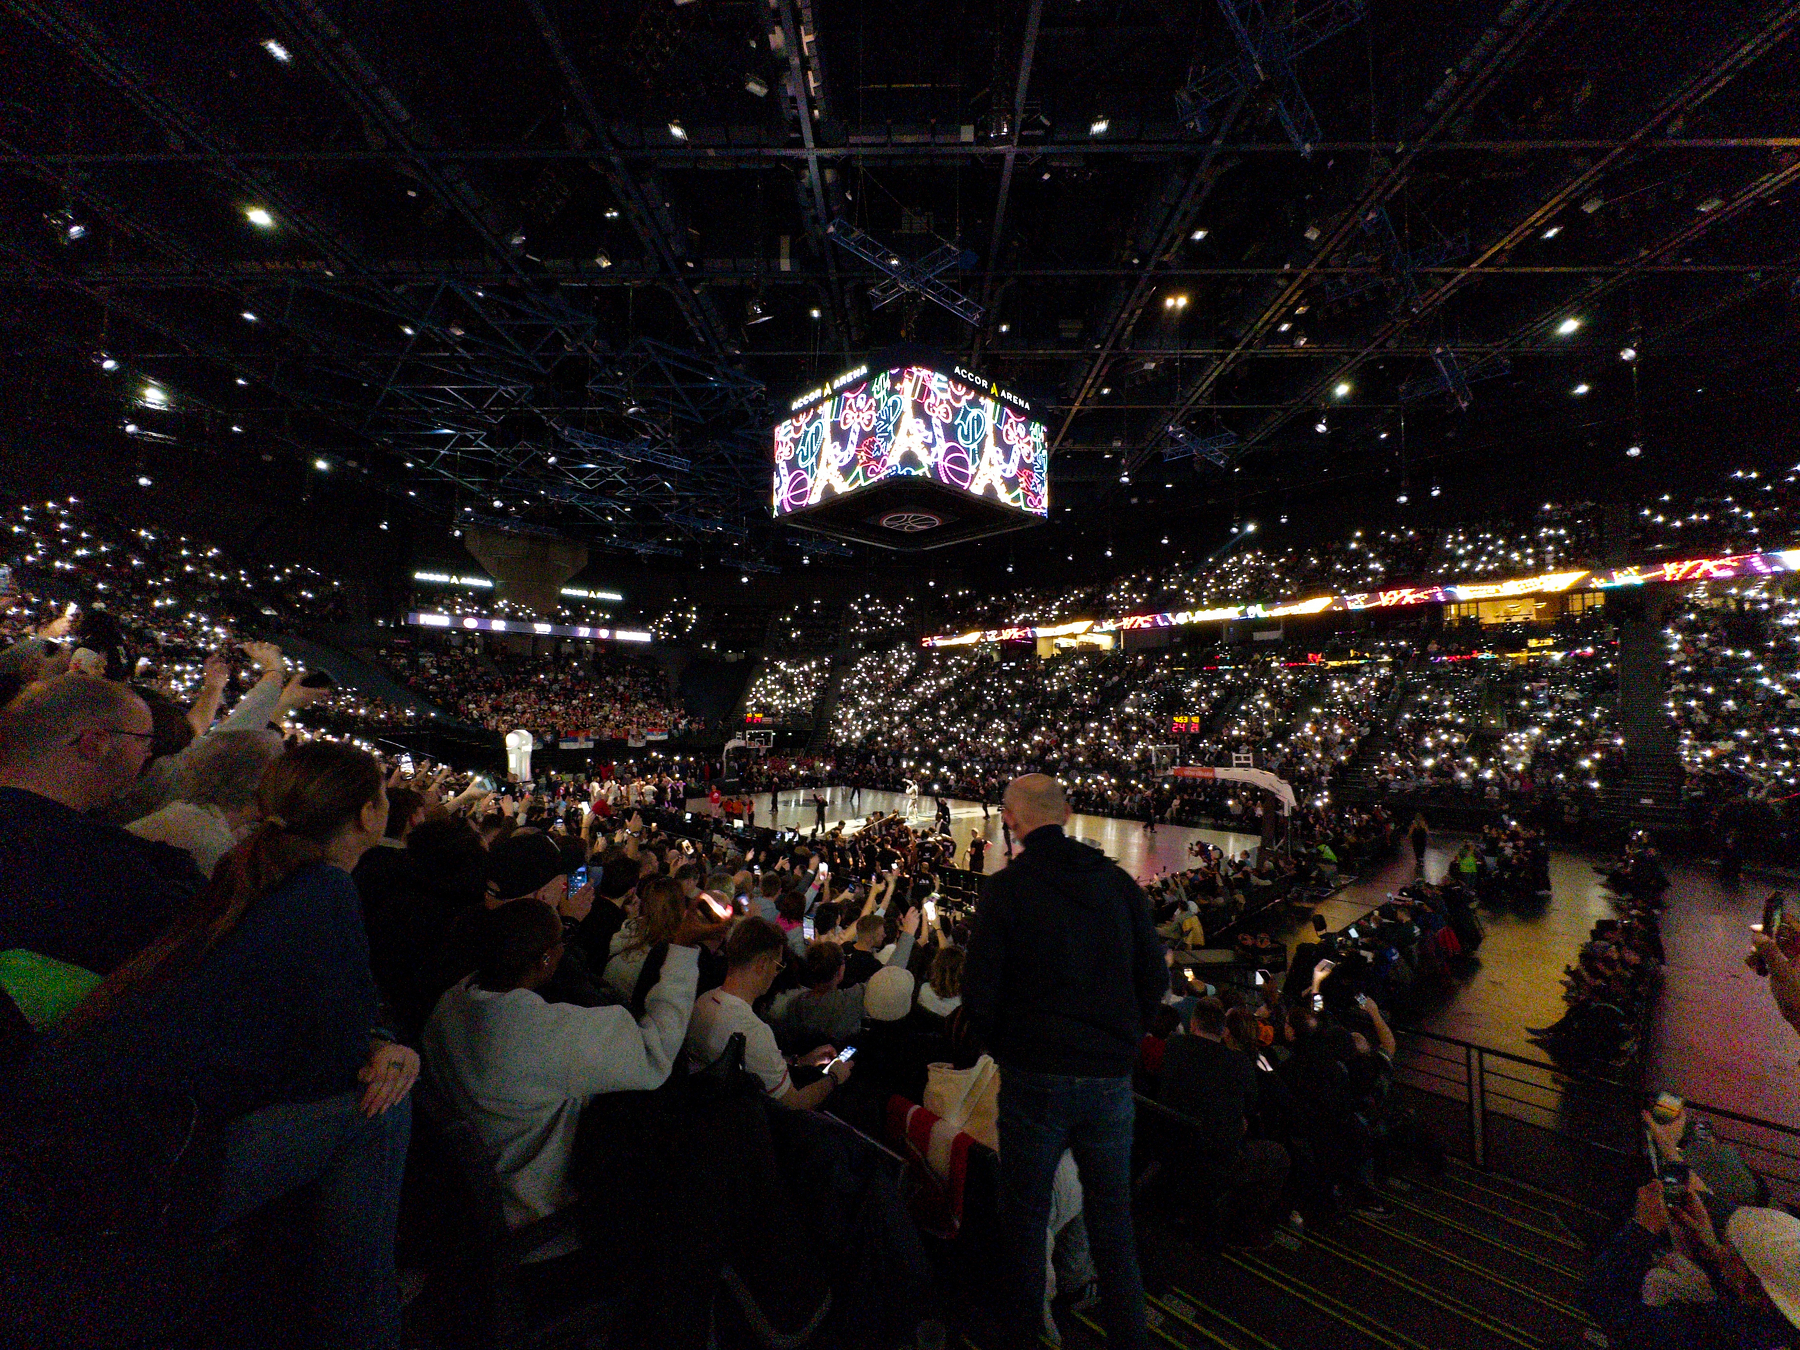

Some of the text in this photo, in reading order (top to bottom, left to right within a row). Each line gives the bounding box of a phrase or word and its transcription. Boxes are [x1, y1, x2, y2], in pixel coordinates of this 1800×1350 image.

[791, 388, 822, 411] ACCOR
[833, 365, 868, 389] ARENA
[955, 366, 988, 389] ACCOR
[1000, 389, 1031, 411] ARENA
[1172, 723, 1186, 732] 24
